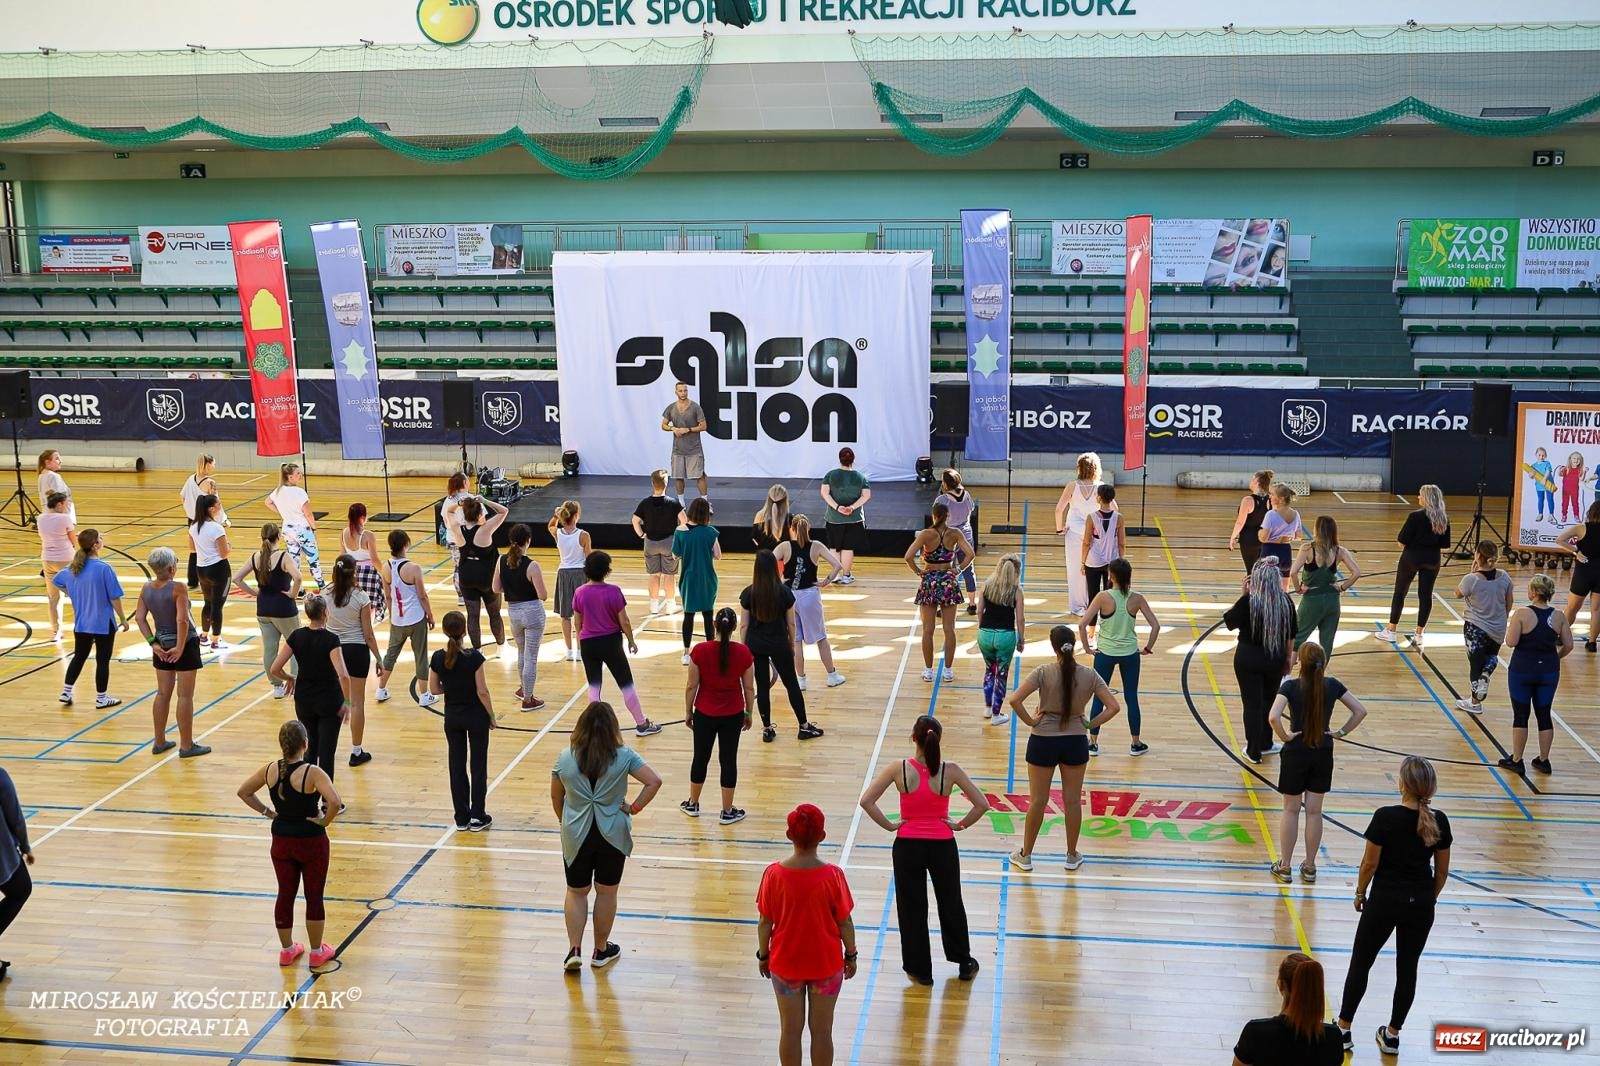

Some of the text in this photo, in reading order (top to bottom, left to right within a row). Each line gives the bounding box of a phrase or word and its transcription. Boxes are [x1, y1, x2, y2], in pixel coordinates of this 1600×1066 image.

[647, 0, 767, 25] SPOU
[779, 0, 786, 22] I
[799, 0, 964, 21] REKREACJI
[1062, 158, 1072, 167] C
[1077, 158, 1087, 167] C
[1536, 155, 1550, 165] D
[1554, 155, 1563, 165] D
[189, 168, 202, 177] A
[1061, 223, 1123, 236] MIESZKO
[1528, 218, 1596, 234] WSZYSTKO
[392, 227, 447, 239] MIESZKO
[1452, 226, 1509, 244] ZOO
[1447, 244, 1506, 262] MAR
[1447, 262, 1506, 270] sklep zoologiczny
[1420, 276, 1506, 287] WWW.ZOO-MAR.PL
[38, 393, 101, 416] OSiR
[205, 402, 317, 420] RACIZ
[1149, 404, 1223, 429] OSiR
[63, 417, 102, 425] RACIBÓRZ
[1546, 410, 1592, 427] DBAMY
[393, 420, 433, 429] RACIBÓRZ
[1177, 429, 1223, 438] RACIBÓRZ
